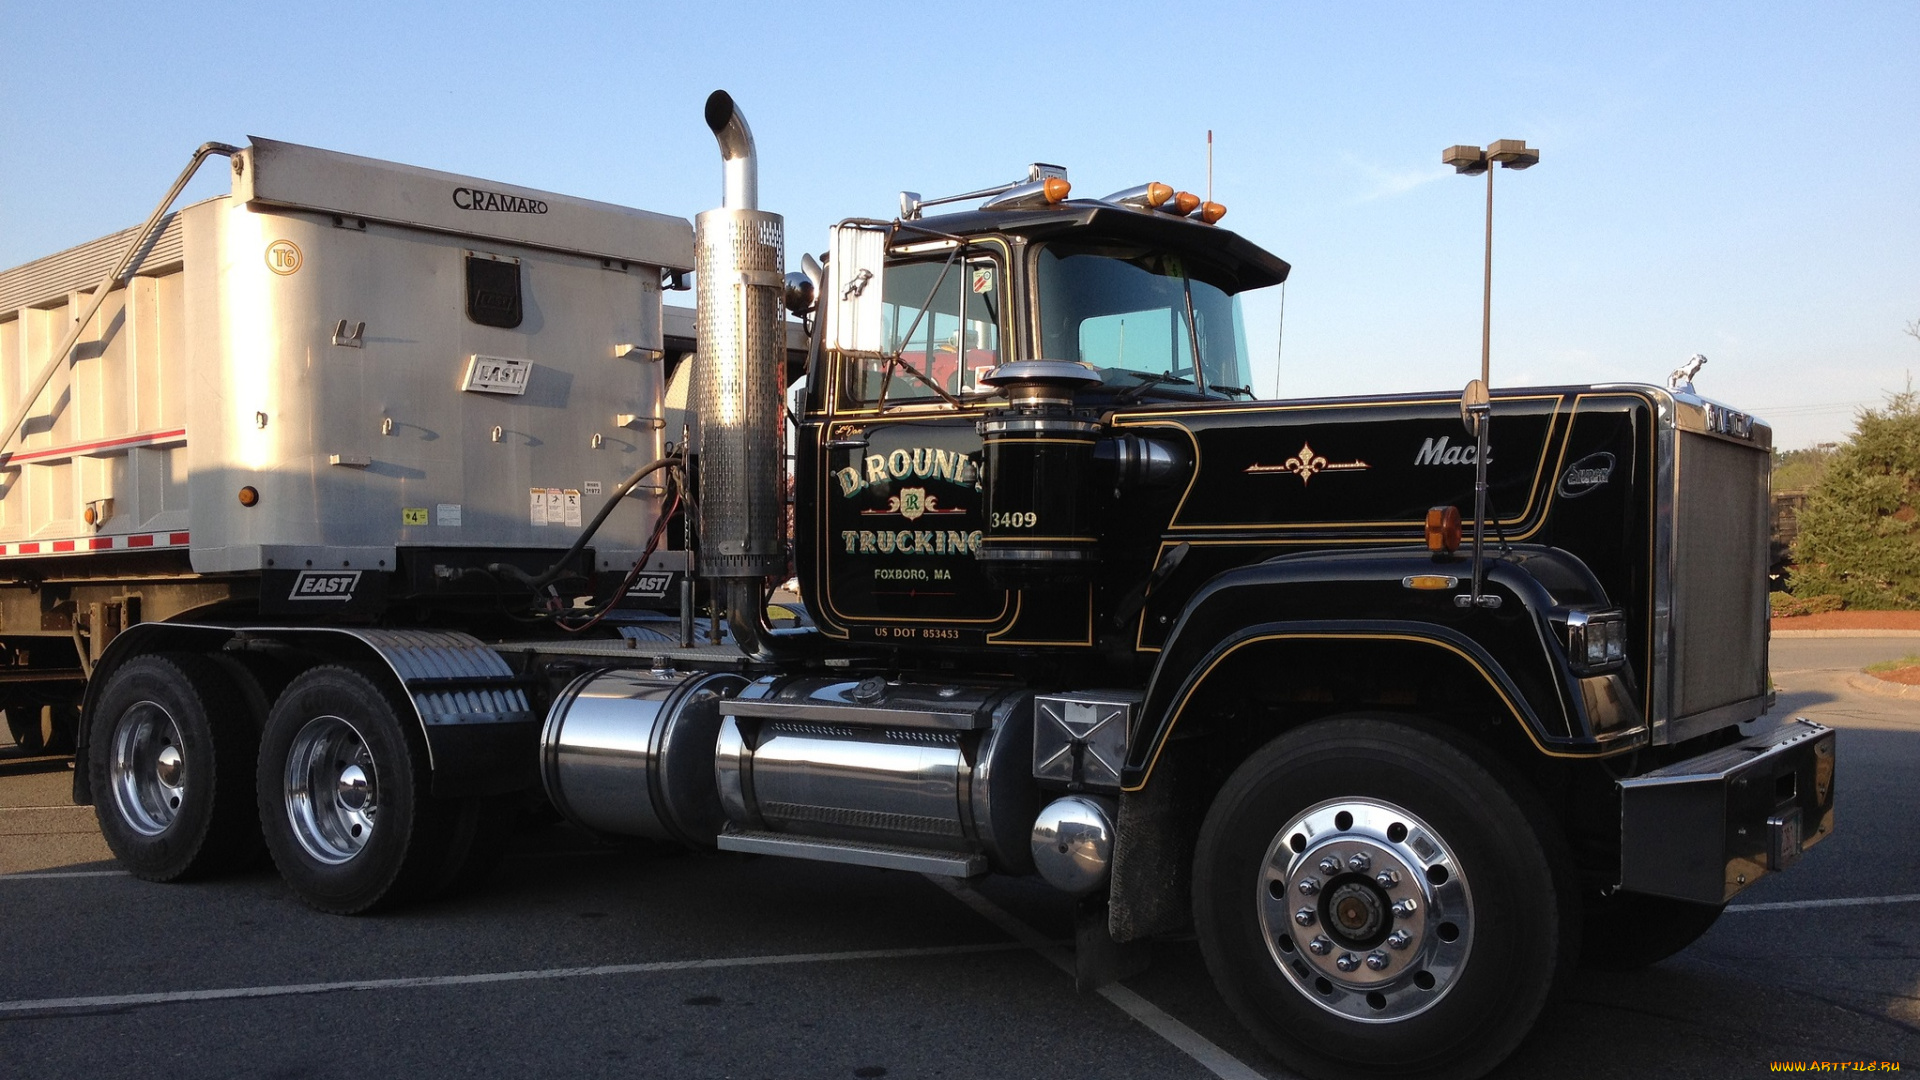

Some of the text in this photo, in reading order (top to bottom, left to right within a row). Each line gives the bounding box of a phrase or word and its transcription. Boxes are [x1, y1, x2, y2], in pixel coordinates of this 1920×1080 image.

[453, 187, 548, 214] CRAMARO
[273, 249, 296, 267] T6
[905, 493, 920, 511] R
[992, 512, 1037, 528] 3409
[841, 530, 983, 554] TRUCKING
[874, 569, 951, 581] FOXBORO, MA
[300, 577, 353, 593] EAST
[874, 628, 959, 639] US DOT 853453
